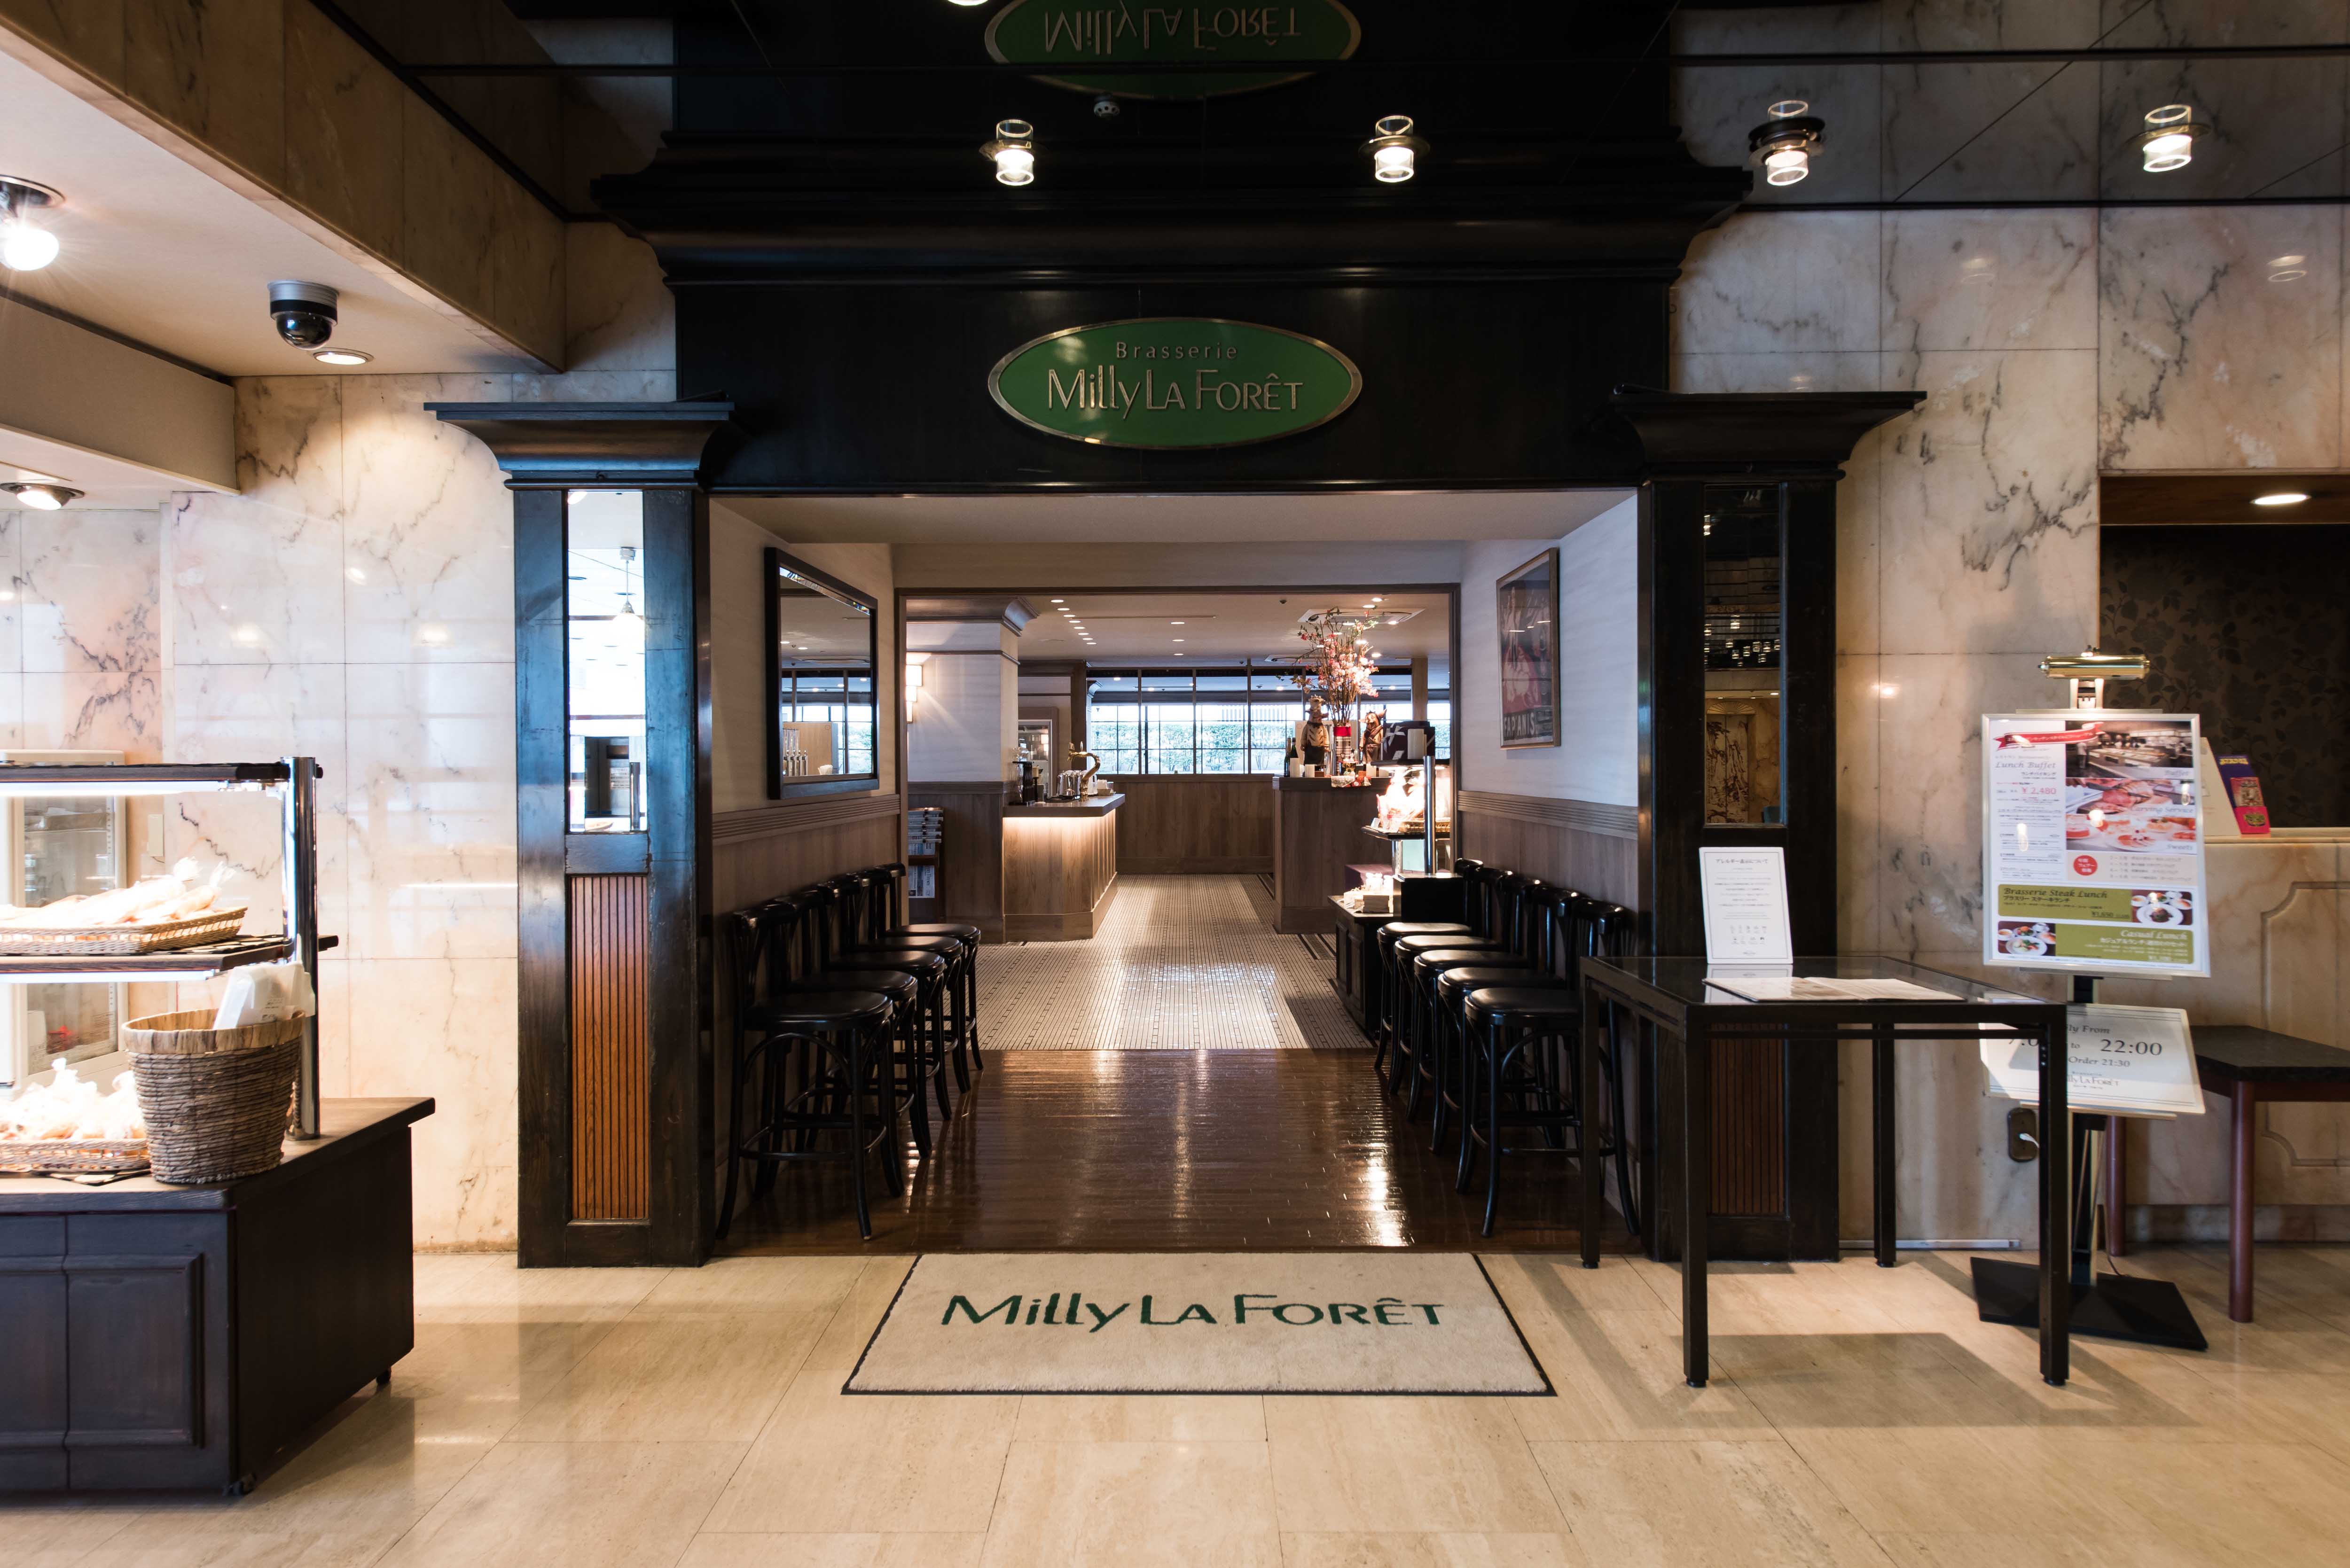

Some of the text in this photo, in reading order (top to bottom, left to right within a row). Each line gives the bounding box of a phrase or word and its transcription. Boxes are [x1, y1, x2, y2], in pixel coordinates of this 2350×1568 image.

[1116, 341, 1238, 360] Brasserie
[1048, 364, 1304, 420] Milly LA FORÊT
[2027, 762, 2056, 770] Buffet
[2004, 887, 2107, 898] Brasserie Steak Lunch
[2120, 929, 2188, 940] Casual Lunch
[2083, 1025, 2110, 1033] From
[2100, 1038, 2162, 1056] 22:00
[2068, 1056, 2131, 1068] Order 21:30
[941, 1293, 1445, 1334] Milly LA FORÊT
